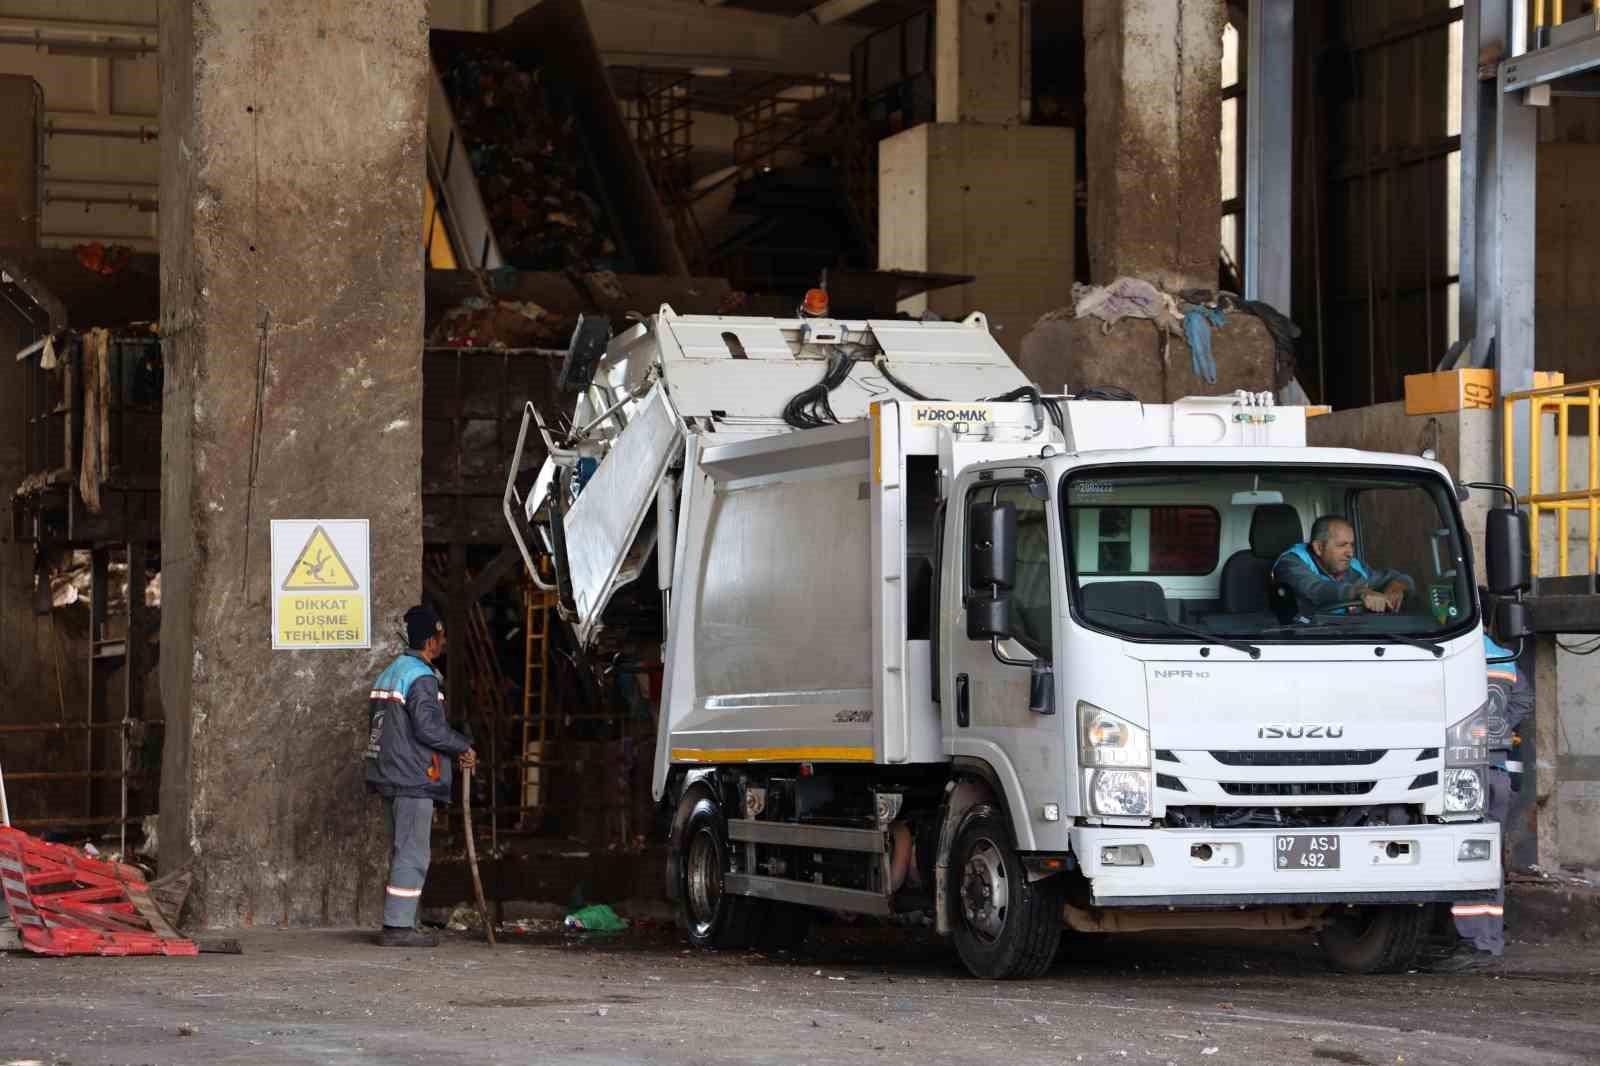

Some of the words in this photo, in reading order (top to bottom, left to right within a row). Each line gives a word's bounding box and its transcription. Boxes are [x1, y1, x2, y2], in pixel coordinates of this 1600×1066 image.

[295, 598, 348, 610] DİKKAT
[295, 613, 348, 628] DÜŞME
[283, 628, 360, 641] TEHLİKESİ
[1257, 726, 1343, 739] ISUZU
[1279, 837, 1296, 851] 07
[1310, 837, 1337, 851] ASJ
[1300, 853, 1325, 867] 492
